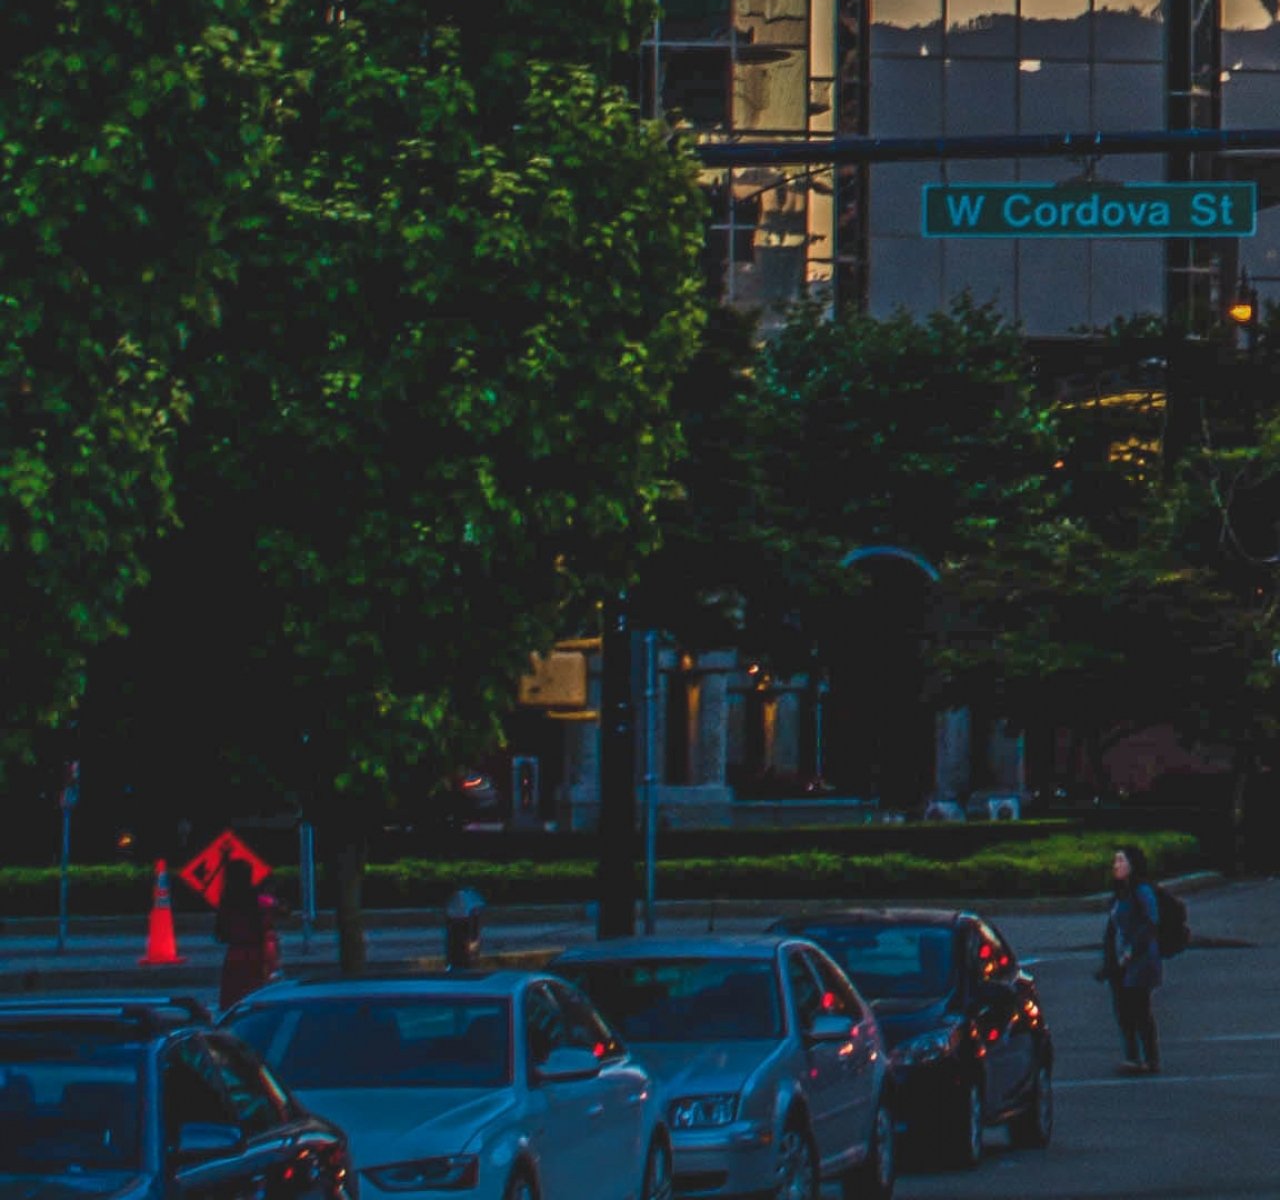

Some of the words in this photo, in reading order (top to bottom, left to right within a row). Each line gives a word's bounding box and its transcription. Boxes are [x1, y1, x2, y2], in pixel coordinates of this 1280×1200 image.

[946, 195, 984, 227] W
[1003, 192, 1170, 228] Cordova
[1190, 191, 1234, 227] St
